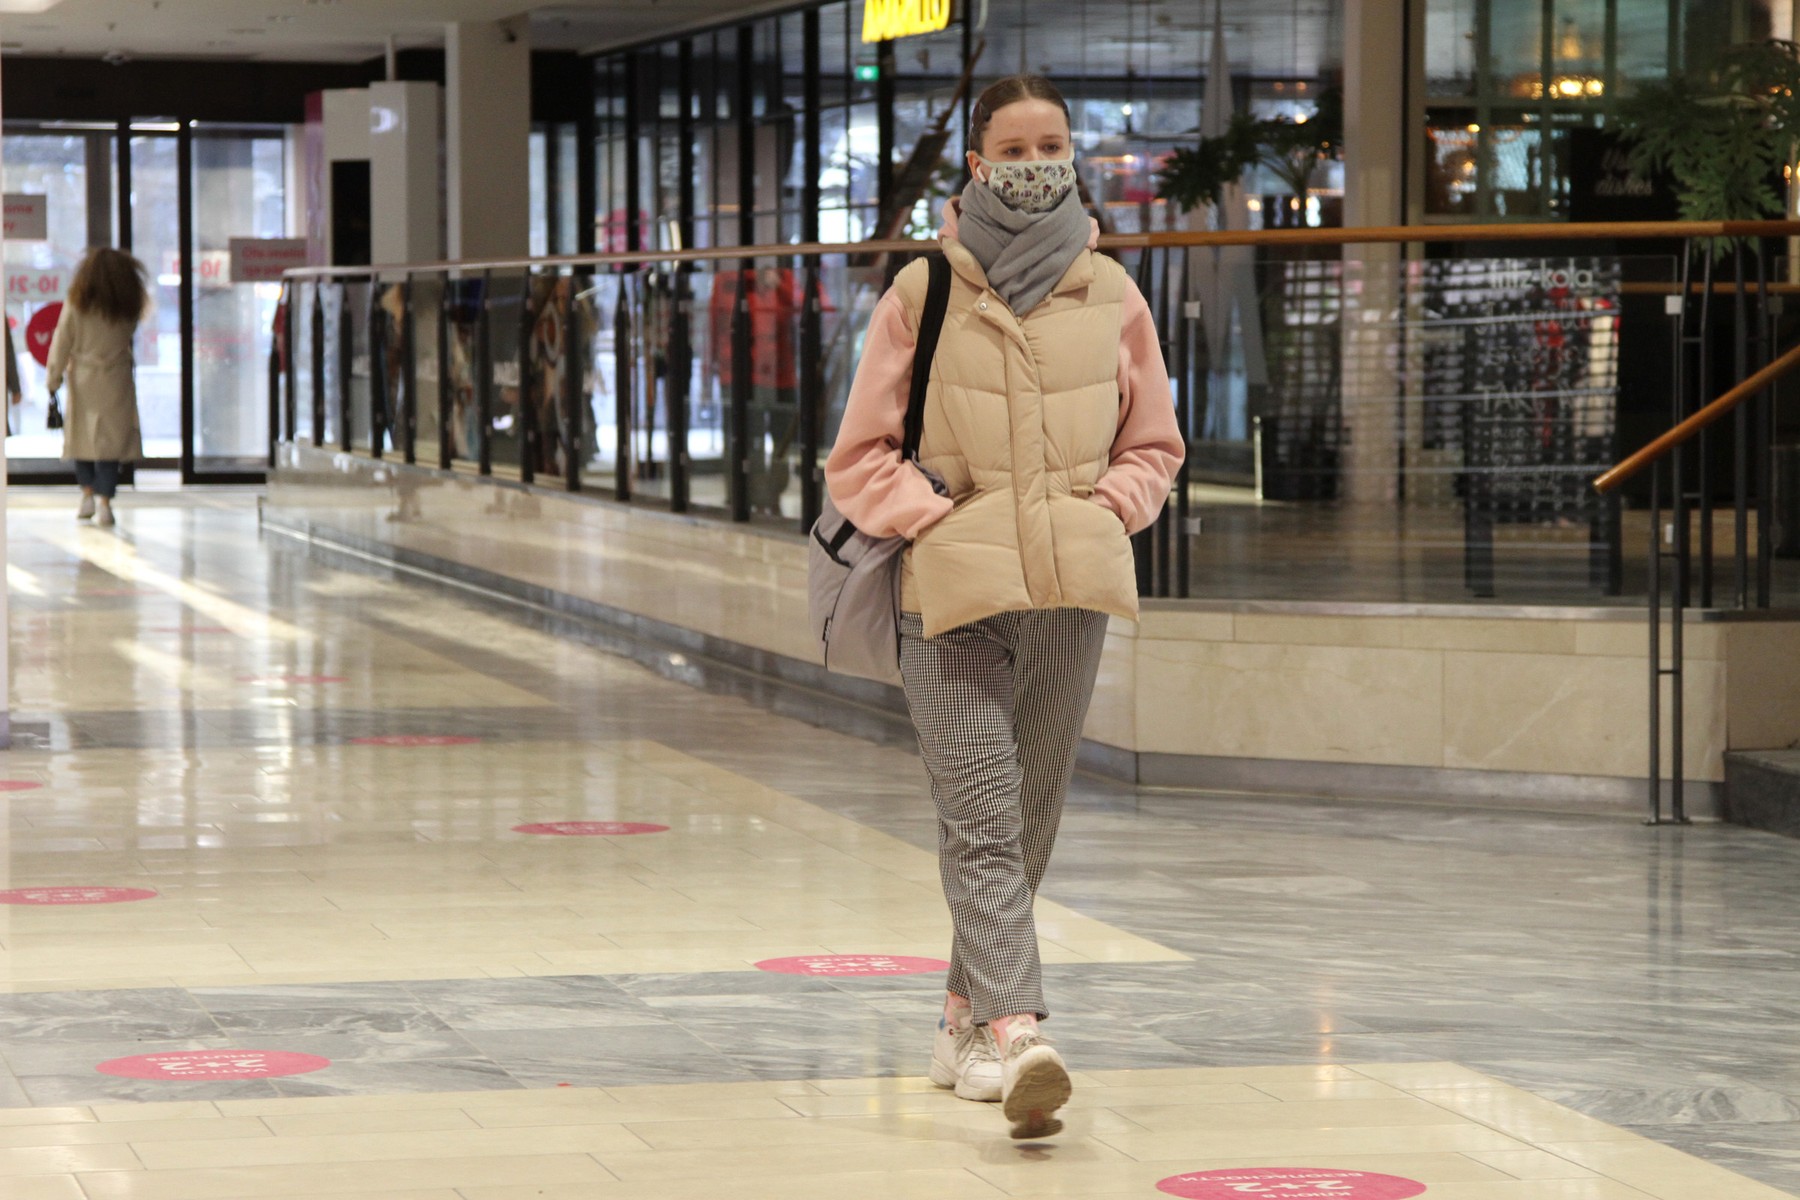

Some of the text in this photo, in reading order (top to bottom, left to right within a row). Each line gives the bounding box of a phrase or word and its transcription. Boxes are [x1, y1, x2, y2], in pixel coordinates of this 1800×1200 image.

[804, 960, 899, 968] 2+2
[157, 1059, 267, 1070] 2+2
[1180, 1173, 1364, 1182] БЕЗОПАСНОСТИ
[1225, 1181, 1354, 1192] 2+2
